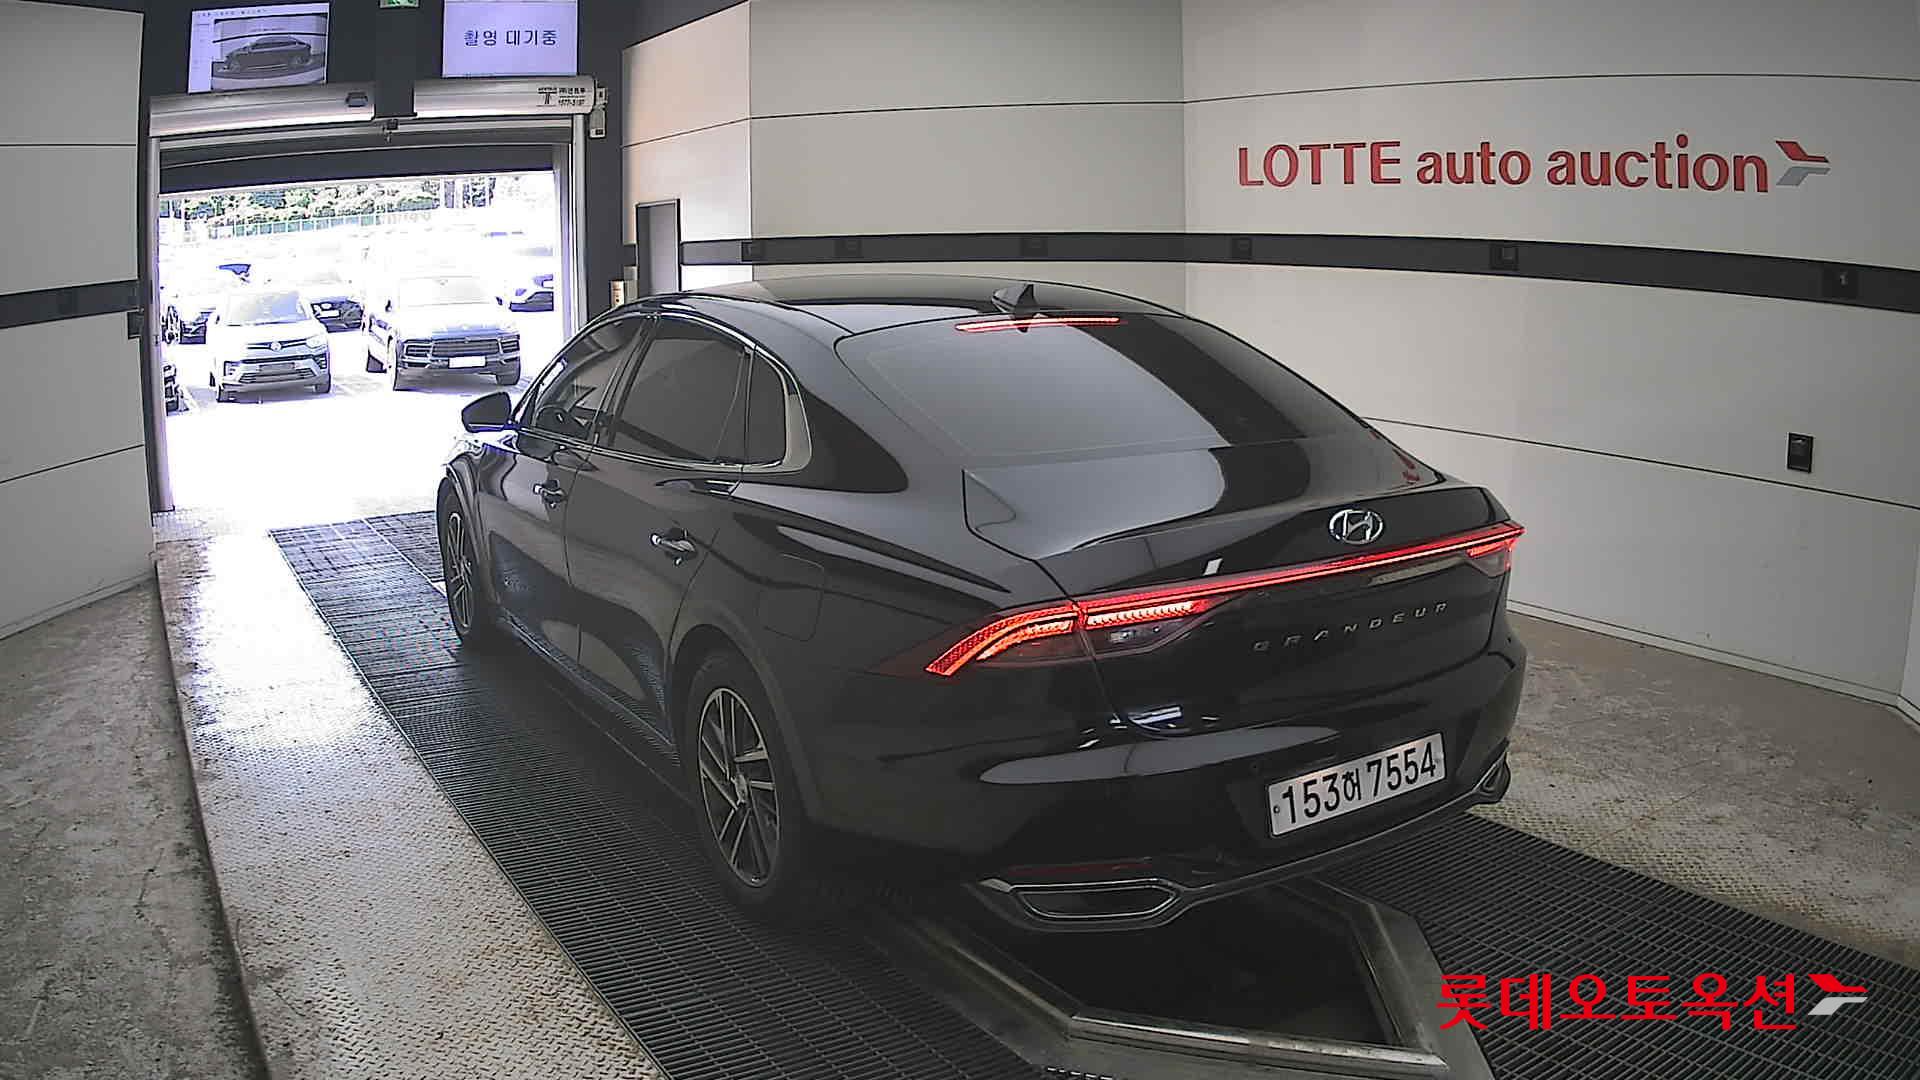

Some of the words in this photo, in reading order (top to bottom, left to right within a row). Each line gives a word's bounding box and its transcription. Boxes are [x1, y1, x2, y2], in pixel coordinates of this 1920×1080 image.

[506, 30, 557, 46] 대기중
[1238, 141, 1401, 187] LOTTE
[1416, 141, 1531, 186] auto
[1547, 132, 1769, 193] auction
[1252, 601, 1448, 652] GRANDEUR
[1281, 768, 1362, 824] 153허
[1366, 741, 1437, 797] 7554
